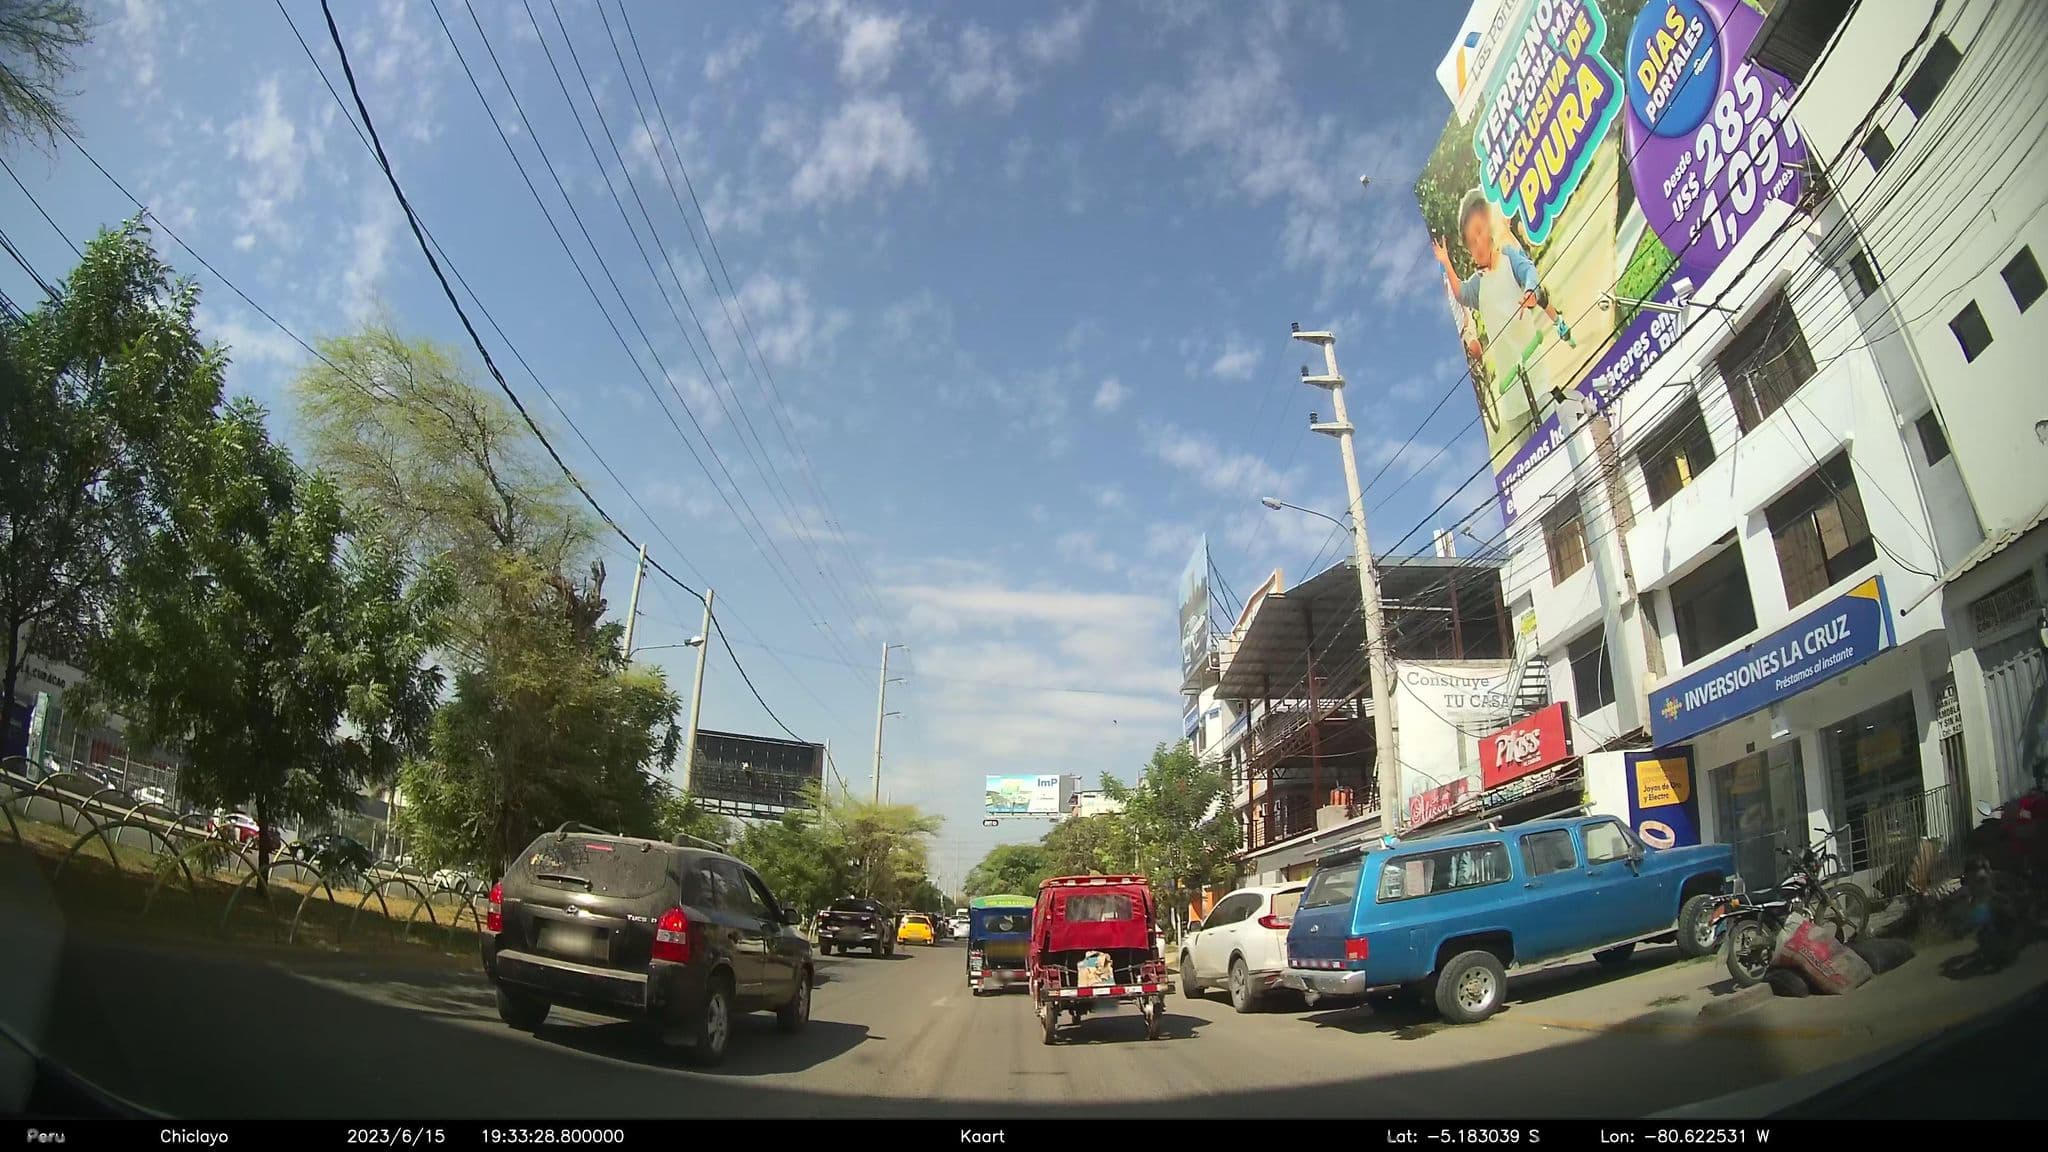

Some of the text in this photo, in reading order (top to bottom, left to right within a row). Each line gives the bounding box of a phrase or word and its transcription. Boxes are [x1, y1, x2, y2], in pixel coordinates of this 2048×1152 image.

[1480, 0, 1562, 155] TERRENO
[1637, 5, 1685, 95] DÍAS
[1645, 16, 1704, 124] PORTALES
[1486, 143, 1504, 186] EN
[1501, 113, 1521, 152] LA
[1516, 43, 1554, 118] ZONA
[1499, 10, 1591, 199] EXCLUSIVA DE
[1519, 63, 1605, 223] PIURA
[1696, 62, 1764, 190] 285
[1663, 150, 1692, 199] Desde
[1672, 170, 1701, 222] US$
[1773, 168, 1794, 198] mes
[1406, 671, 1489, 690] Construye
[1443, 694, 1511, 708] TU CASA
[1684, 613, 1851, 712] INVERSIONES LA CRUZ
[1775, 646, 1854, 692] Préstamos al instante
